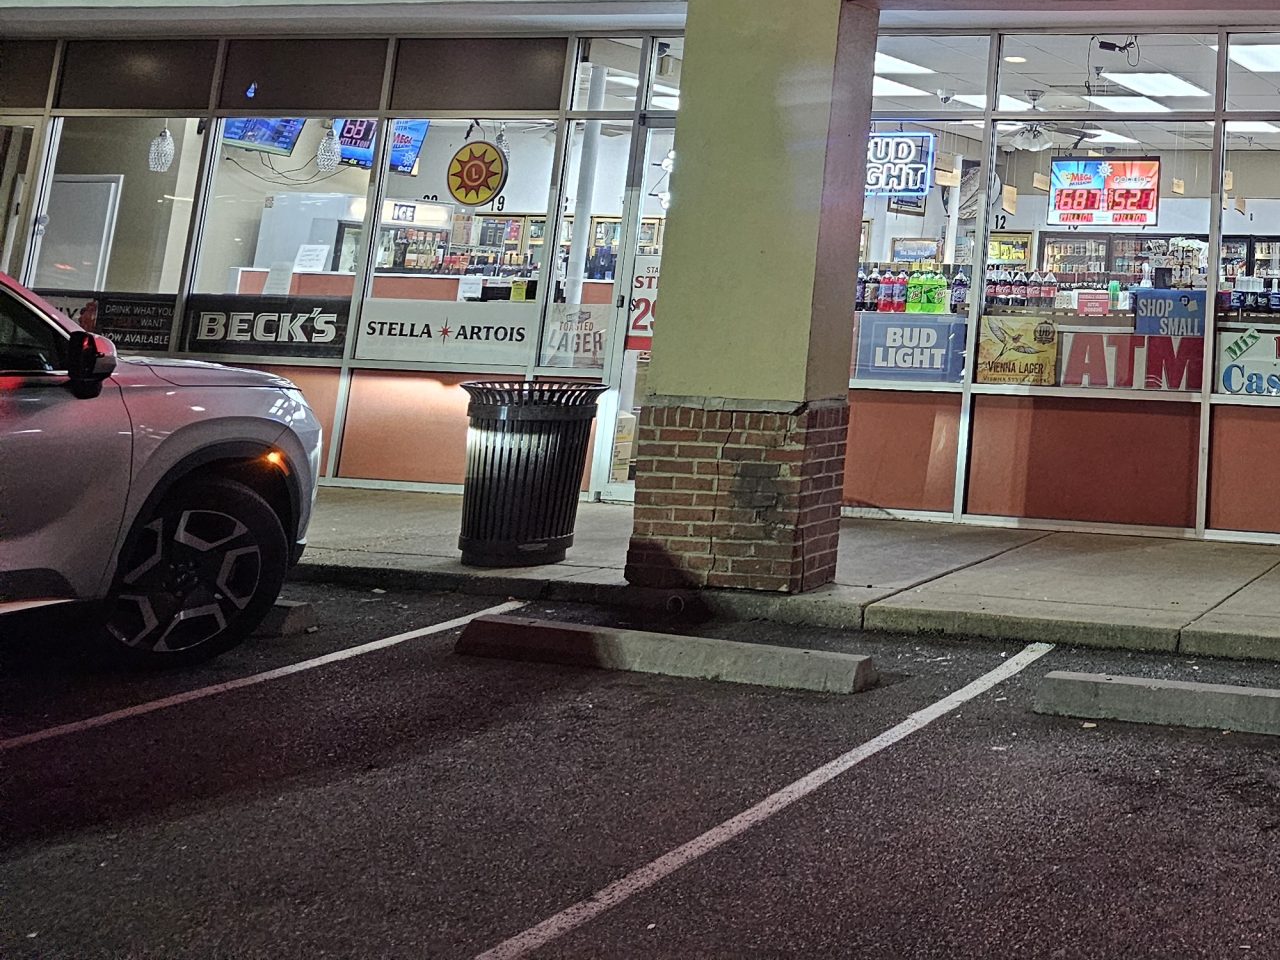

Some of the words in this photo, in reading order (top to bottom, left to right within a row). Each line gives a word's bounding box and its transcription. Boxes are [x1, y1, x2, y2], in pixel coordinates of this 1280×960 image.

[868, 138, 915, 162] UD
[866, 164, 927, 189] GHT
[1060, 189, 1100, 210] 687
[1113, 189, 1154, 210] 521
[394, 204, 414, 220] ICE
[995, 215, 1006, 229] 12
[1060, 213, 1093, 222] MILLION
[1113, 213, 1146, 222] MILLION
[646, 266, 659, 274] STA
[105, 304, 131, 315] DRINK
[133, 307, 158, 317] WHAT
[1138, 298, 1173, 318] SHOP
[140, 318, 166, 328] WANT
[197, 307, 338, 343] BECK'S
[366, 321, 433, 339] STELLA
[454, 324, 527, 343] ARTOIS
[1159, 318, 1200, 336] SMALL
[124, 333, 169, 345] AVAILABLE
[549, 328, 603, 354] LAGER
[886, 327, 938, 348] BUD
[1225, 328, 1261, 361] Mix
[874, 348, 946, 369] LIGHT
[987, 361, 1017, 375] VIENNA
[1018, 362, 1045, 376] LAGER
[1063, 333, 1205, 390] ATM
